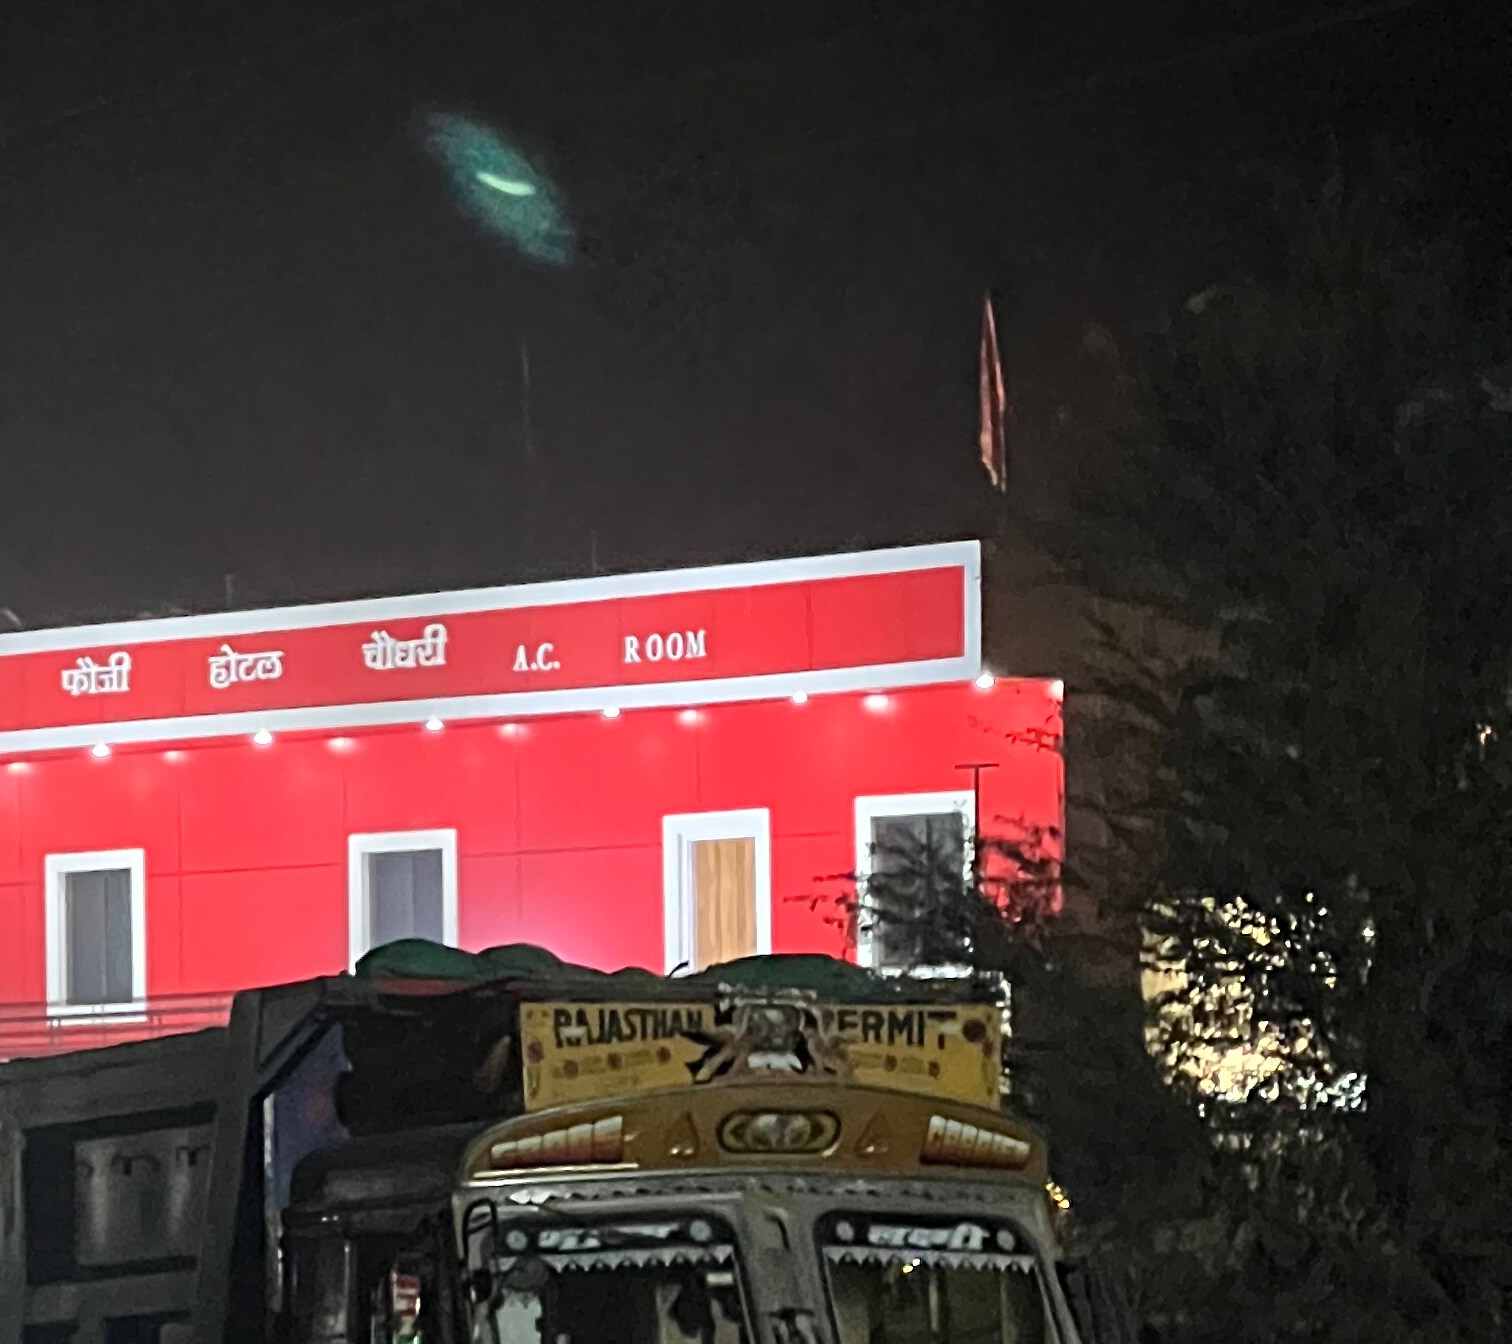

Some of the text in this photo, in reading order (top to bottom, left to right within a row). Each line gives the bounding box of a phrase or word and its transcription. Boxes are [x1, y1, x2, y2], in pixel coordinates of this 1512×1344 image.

[61, 652, 131, 696] फौजी
[207, 644, 284, 689] होटल
[513, 643, 561, 672] A.C.
[623, 629, 707, 663] ROOM
